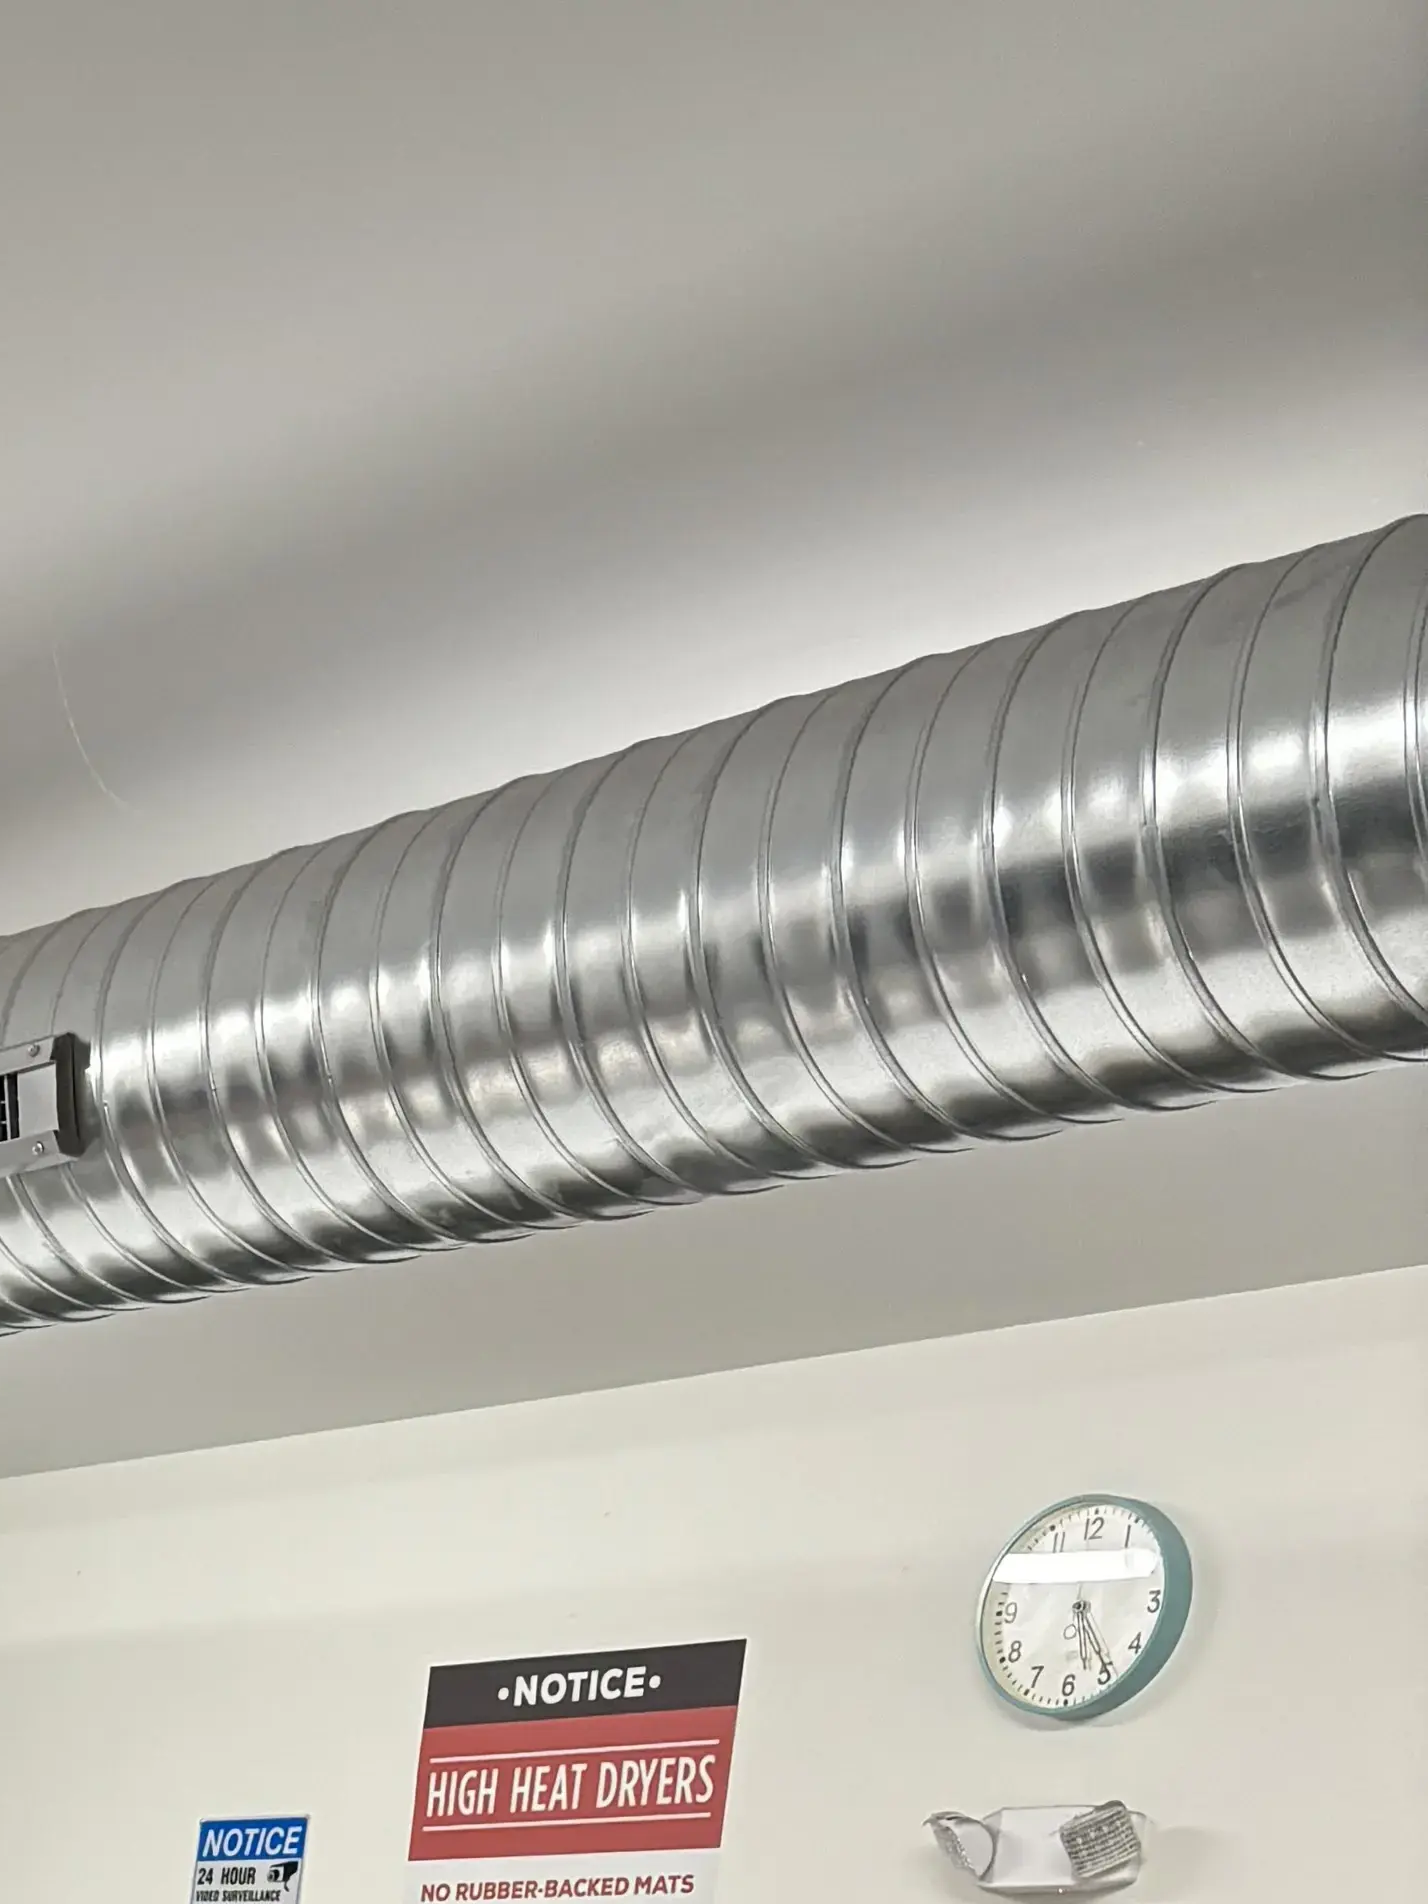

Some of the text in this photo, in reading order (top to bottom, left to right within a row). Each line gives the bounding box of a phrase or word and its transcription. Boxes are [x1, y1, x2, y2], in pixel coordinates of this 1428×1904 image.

[1084, 1517, 1105, 1540] 12
[1004, 1602, 1018, 1623] 9
[1147, 1590, 1161, 1613] 3
[1008, 1640, 1022, 1663] 8
[1128, 1632, 1142, 1654] 4
[1031, 1666, 1044, 1689] 7
[1062, 1674, 1076, 1696] 6
[426, 1754, 716, 1817] HIGH HEAT DRYERS
[202, 1825, 303, 1857] NOTICE
[197, 1866, 257, 1885] 24 HOUR
[421, 1874, 695, 1903] NO RUBBER-BACKED MATS
